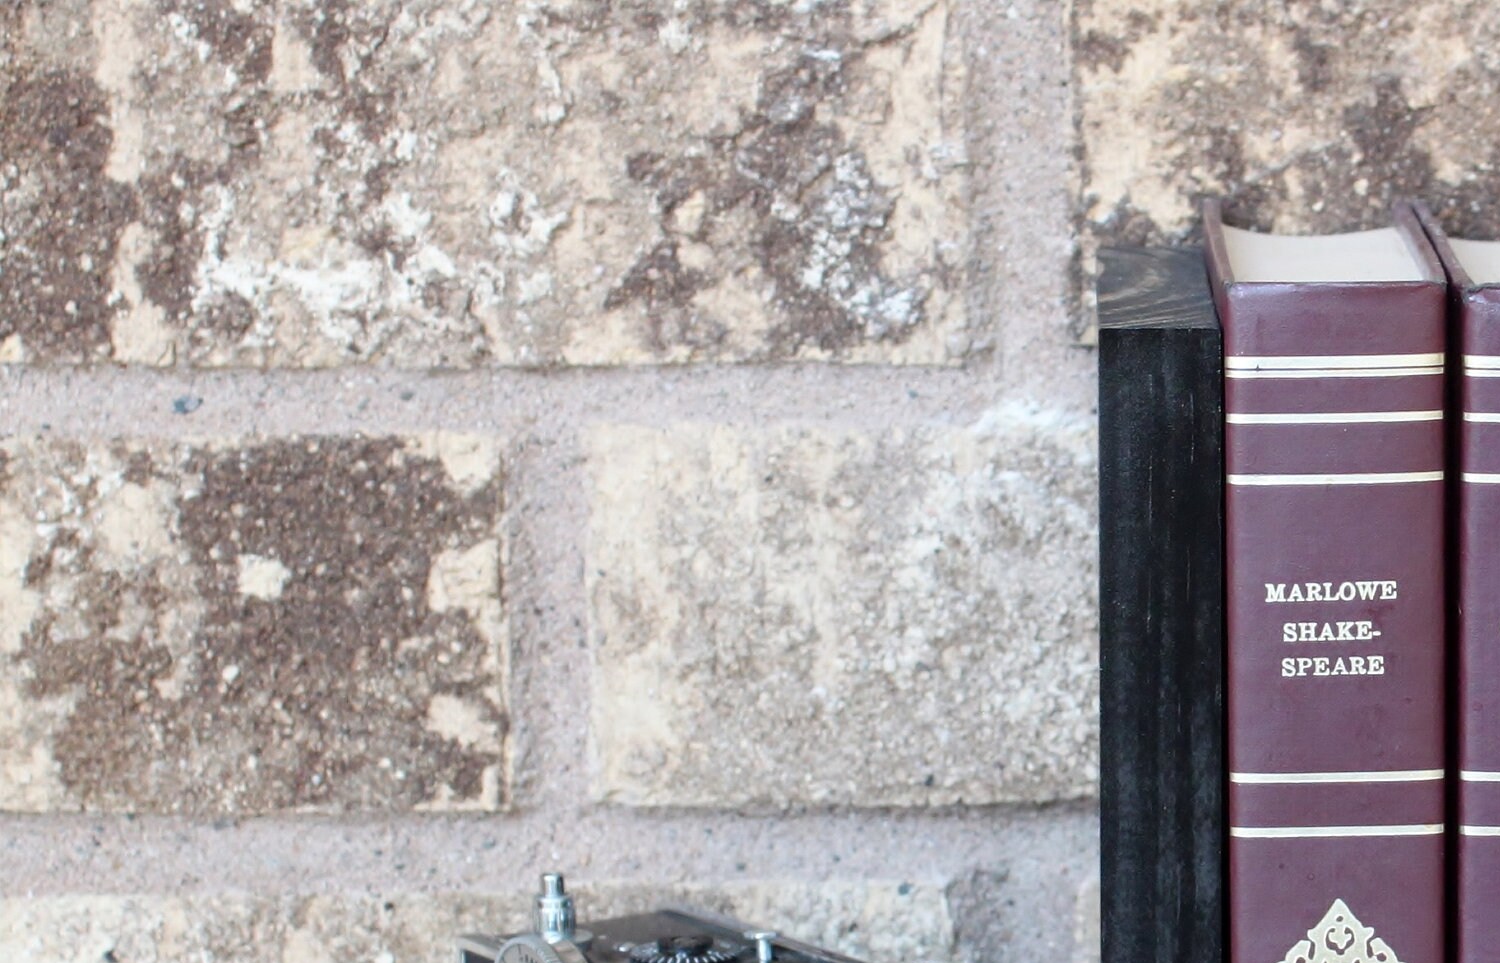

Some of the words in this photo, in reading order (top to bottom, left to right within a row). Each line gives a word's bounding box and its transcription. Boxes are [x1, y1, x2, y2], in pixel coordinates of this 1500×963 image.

[1264, 580, 1398, 604] MARLOWE
[1282, 620, 1382, 643] SHAKE-
[1280, 655, 1385, 678] SPEARE
